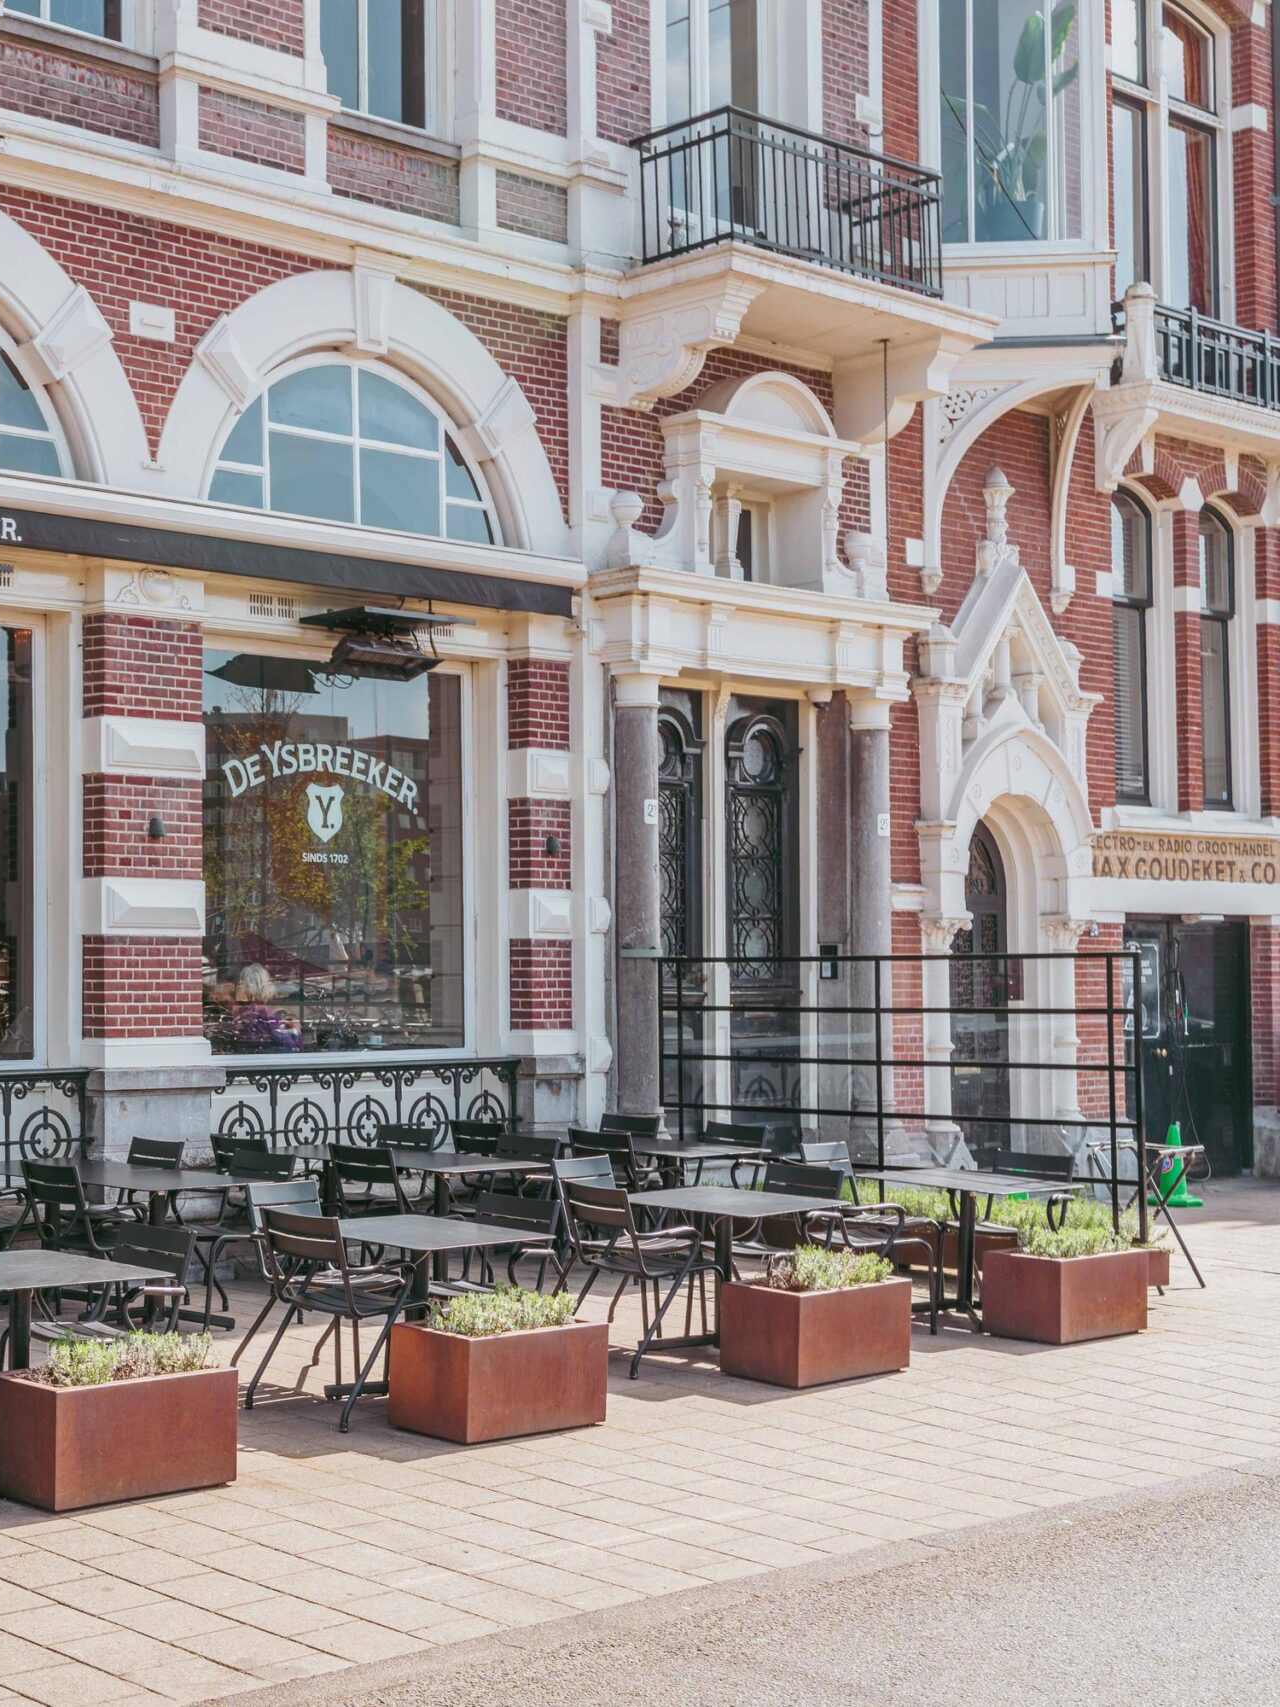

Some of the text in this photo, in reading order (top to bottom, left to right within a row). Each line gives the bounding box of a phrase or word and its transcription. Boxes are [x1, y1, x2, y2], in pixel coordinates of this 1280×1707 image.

[1158, 838, 1192, 854] RADIO
[1197, 841, 1276, 857] GROOTHANDEL
[302, 853, 349, 864] SINDS 1702
[1135, 857, 1236, 882] GOUDEKET
[1240, 870, 1246, 883] &
[1251, 862, 1276, 884] CO
